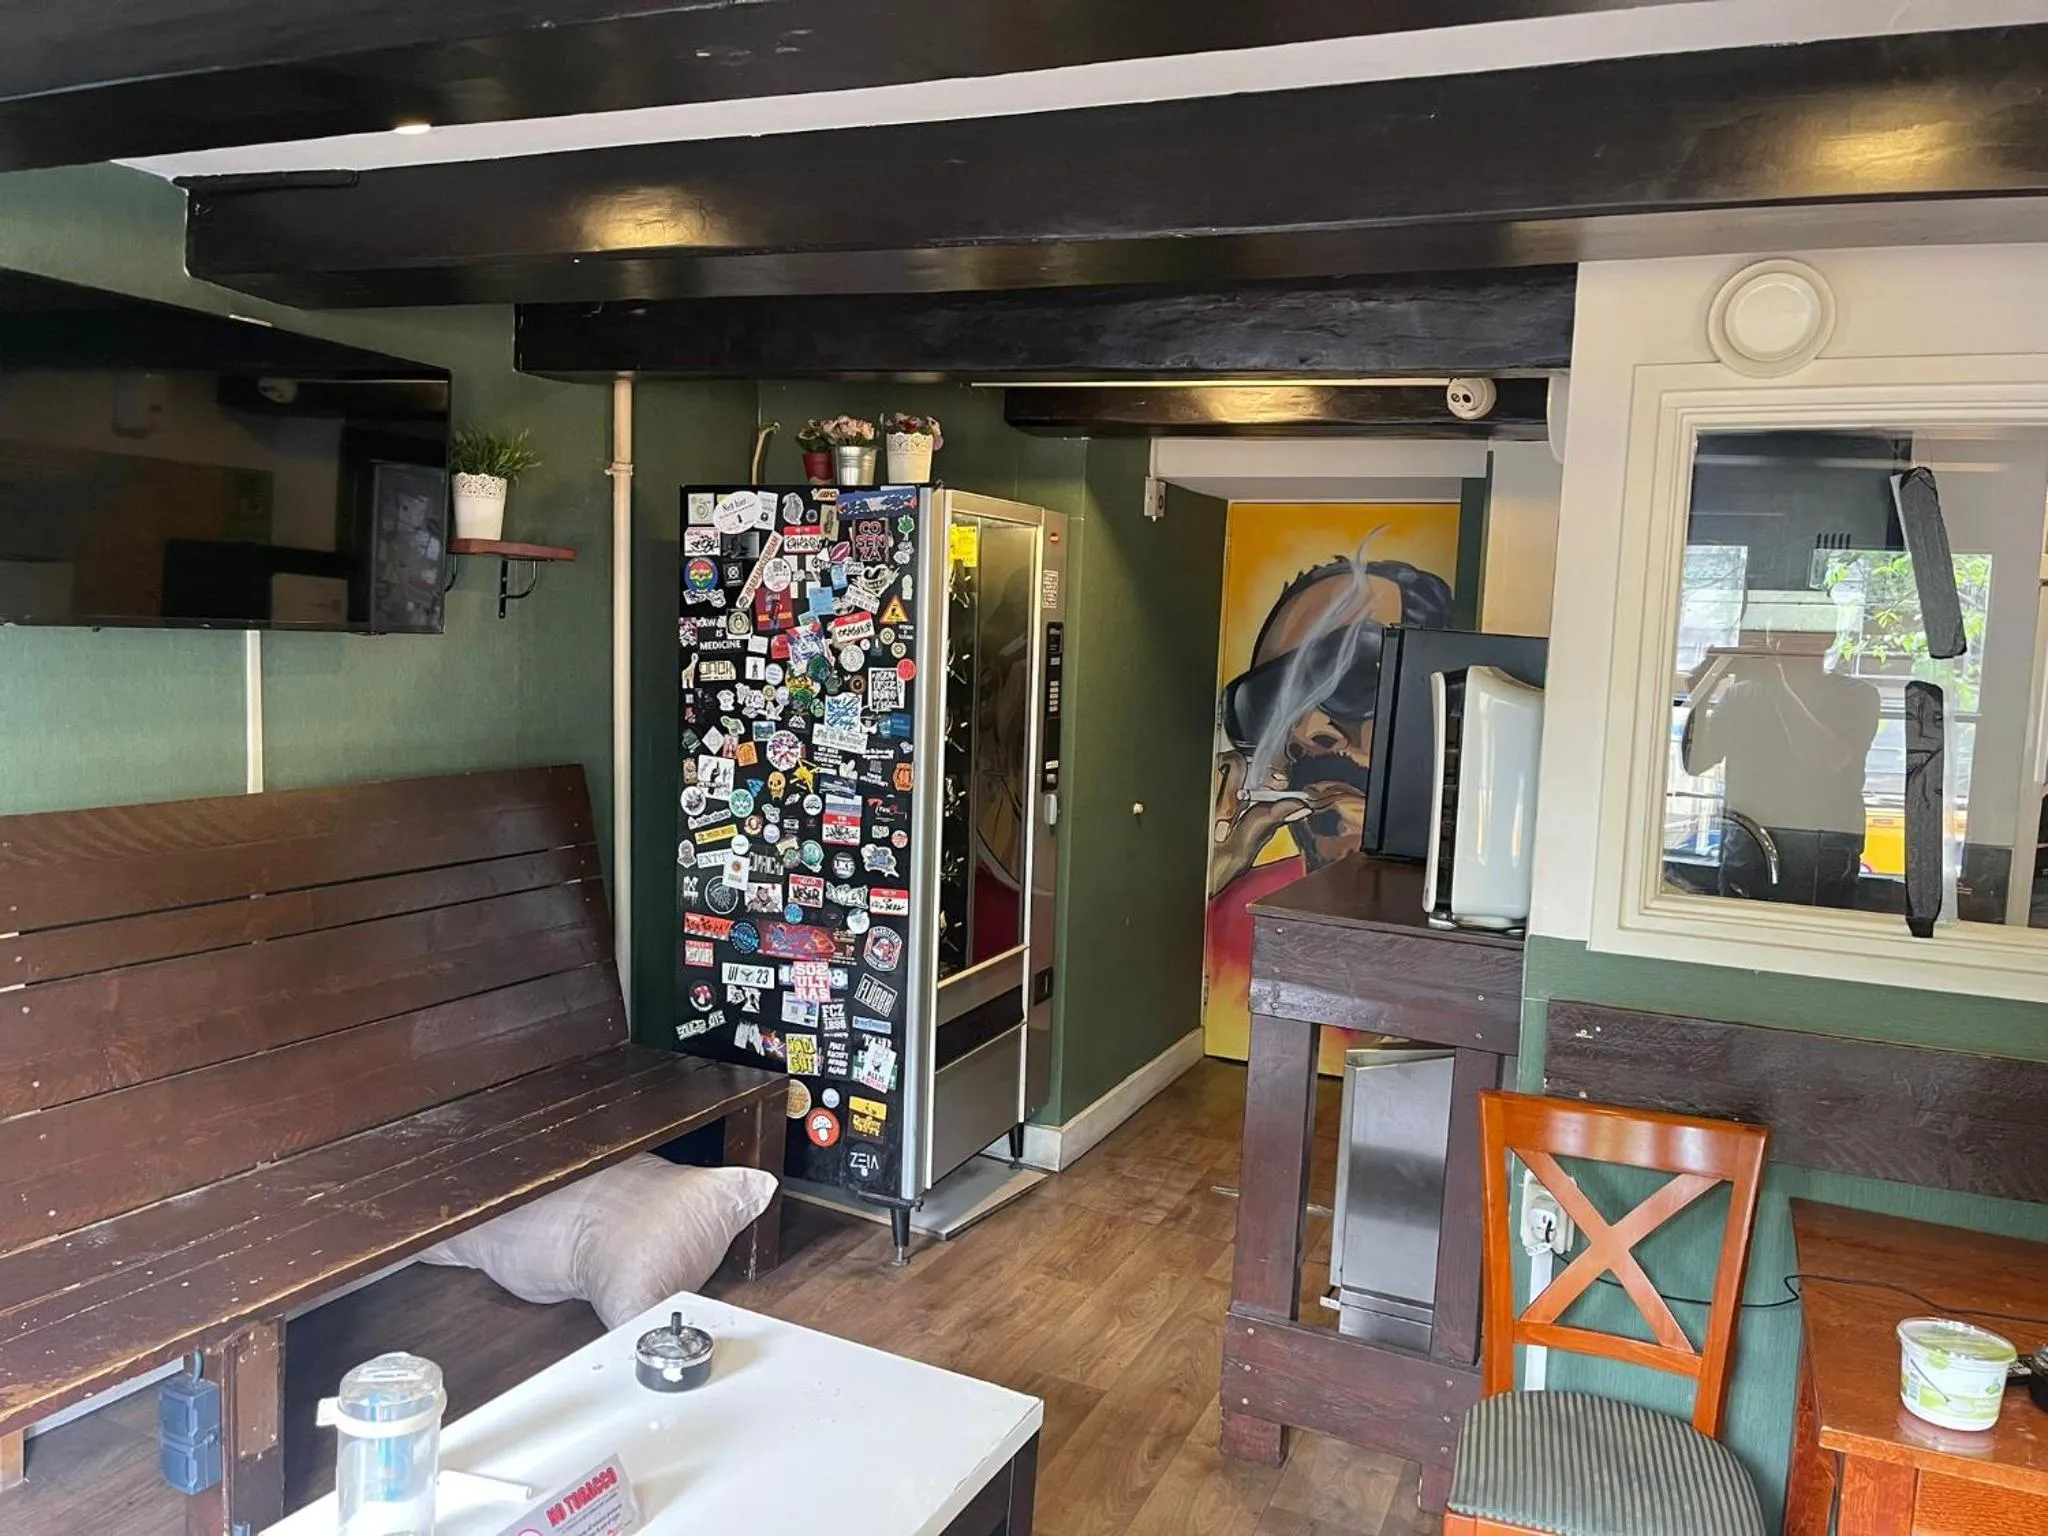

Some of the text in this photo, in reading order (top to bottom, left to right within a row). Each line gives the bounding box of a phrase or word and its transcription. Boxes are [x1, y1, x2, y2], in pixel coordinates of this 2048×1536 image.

[856, 534, 886, 548] SEN
[700, 640, 741, 651] MEDICINE
[756, 969, 769, 984] 23
[821, 1003, 845, 1018] FCZ
[546, 1503, 567, 1527] NO
[563, 1467, 618, 1514] TOBACCO
